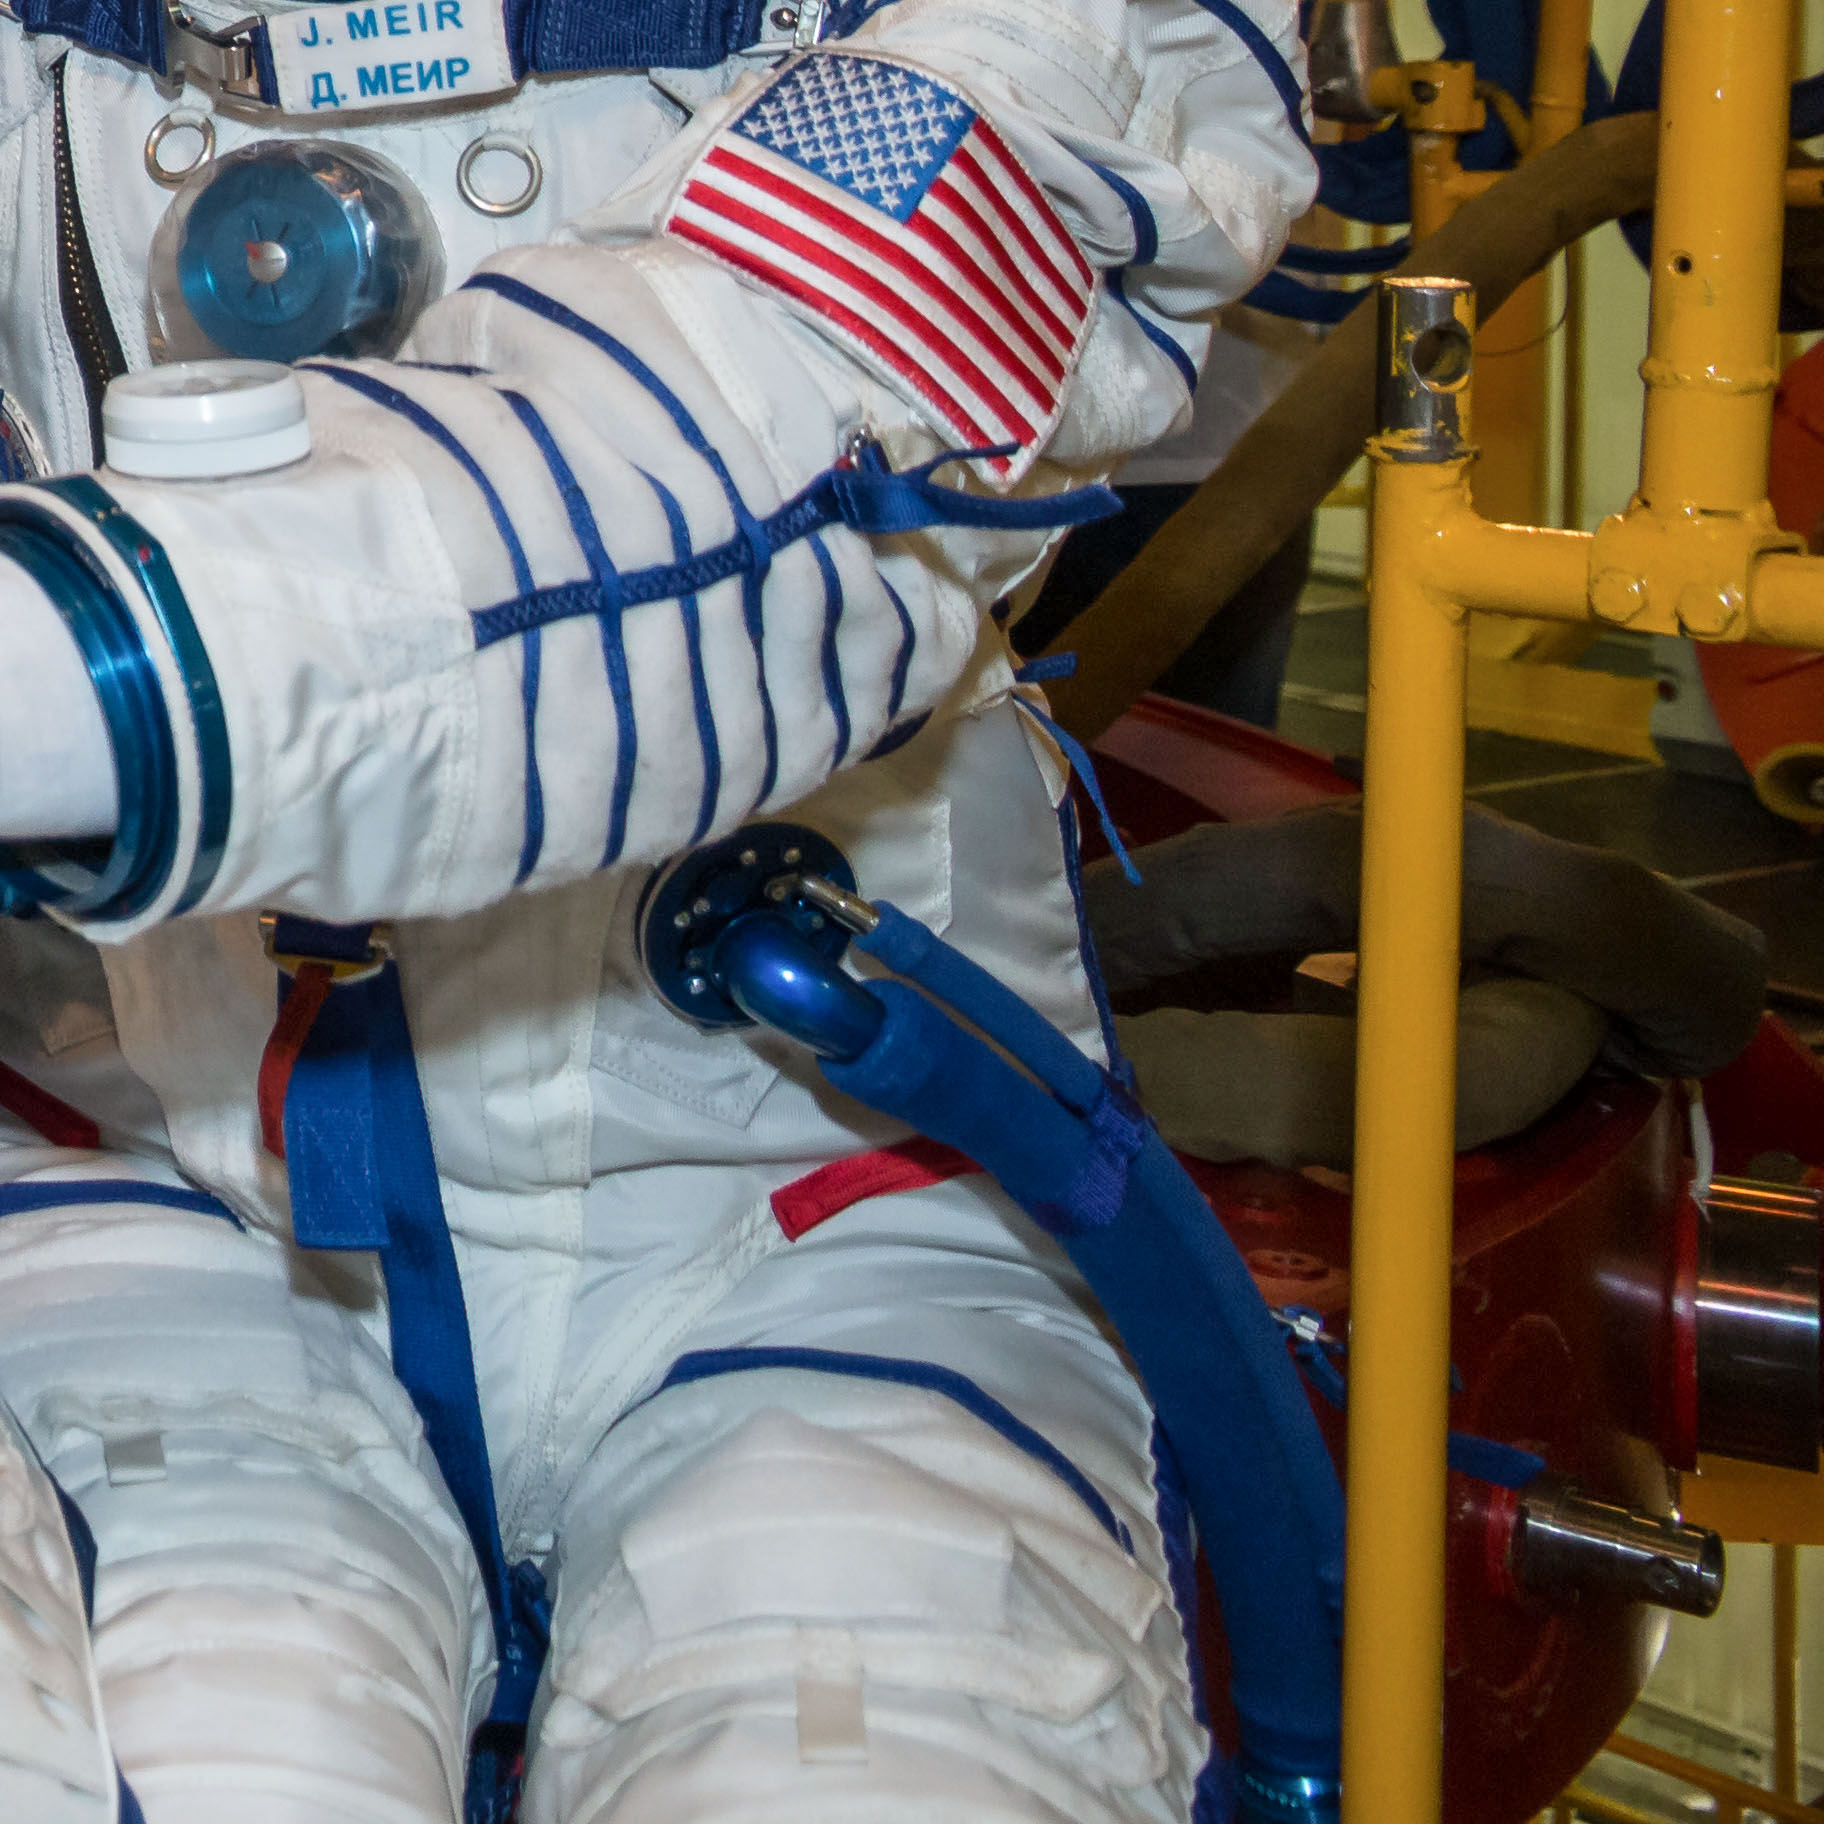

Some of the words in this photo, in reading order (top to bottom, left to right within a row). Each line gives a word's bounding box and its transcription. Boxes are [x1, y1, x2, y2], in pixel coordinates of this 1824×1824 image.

[300, 16, 333, 46] J.
[346, 0, 464, 41] MEIR
[310, 72, 347, 109] Д.
[358, 57, 471, 98] МЕИР
